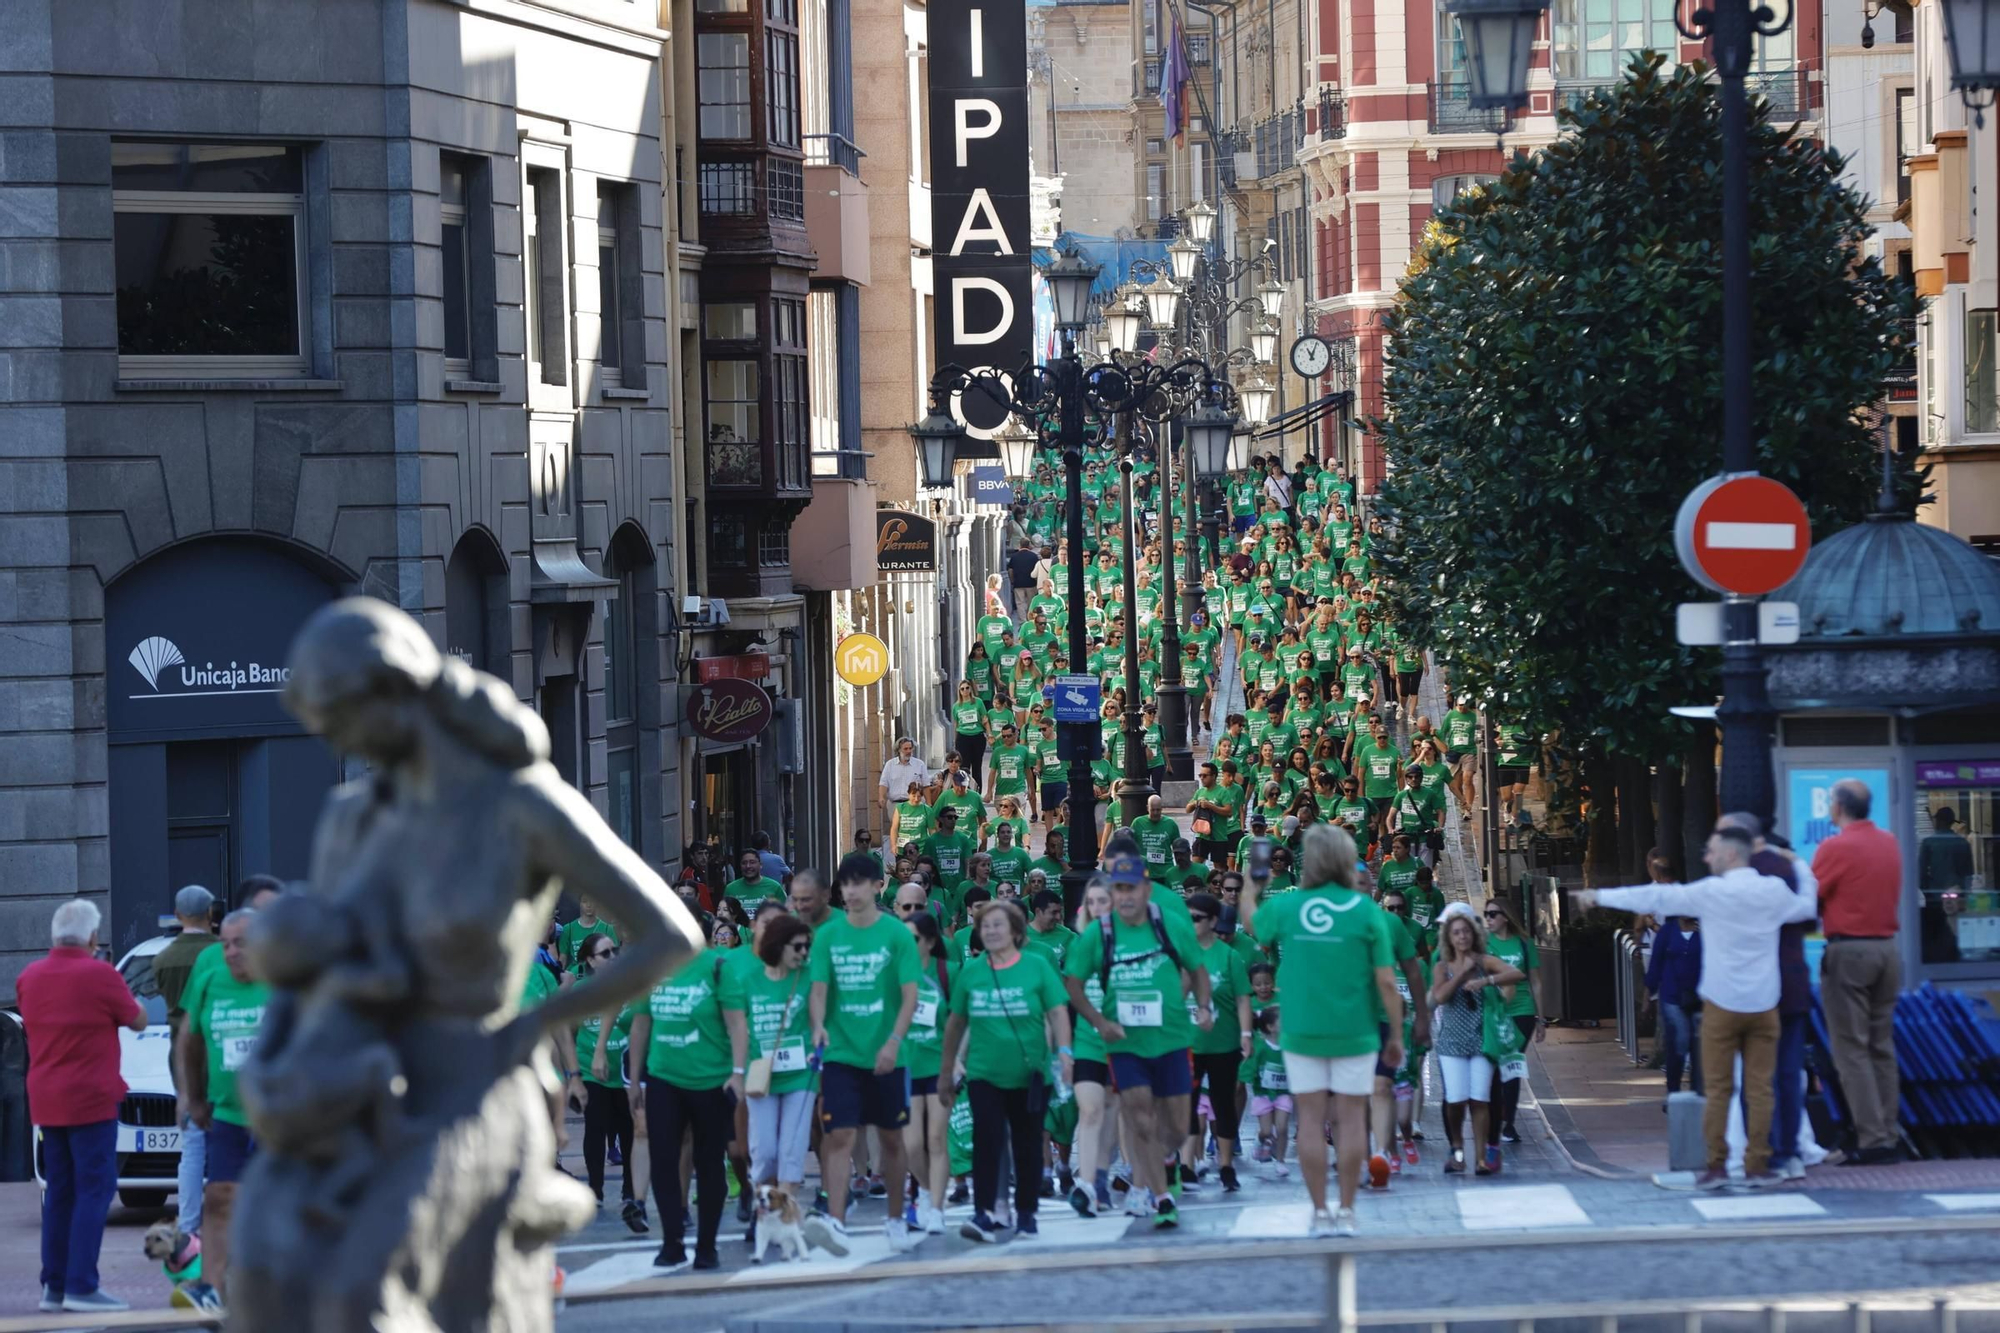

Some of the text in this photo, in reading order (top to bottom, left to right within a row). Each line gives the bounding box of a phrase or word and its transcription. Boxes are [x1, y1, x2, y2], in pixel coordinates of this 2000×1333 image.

[978, 480, 1010, 490] BBVA
[181, 660, 247, 690] Unicaja
[697, 695, 762, 730] Rialto
[777, 1050, 790, 1061] 46
[147, 1132, 179, 1149] 837
